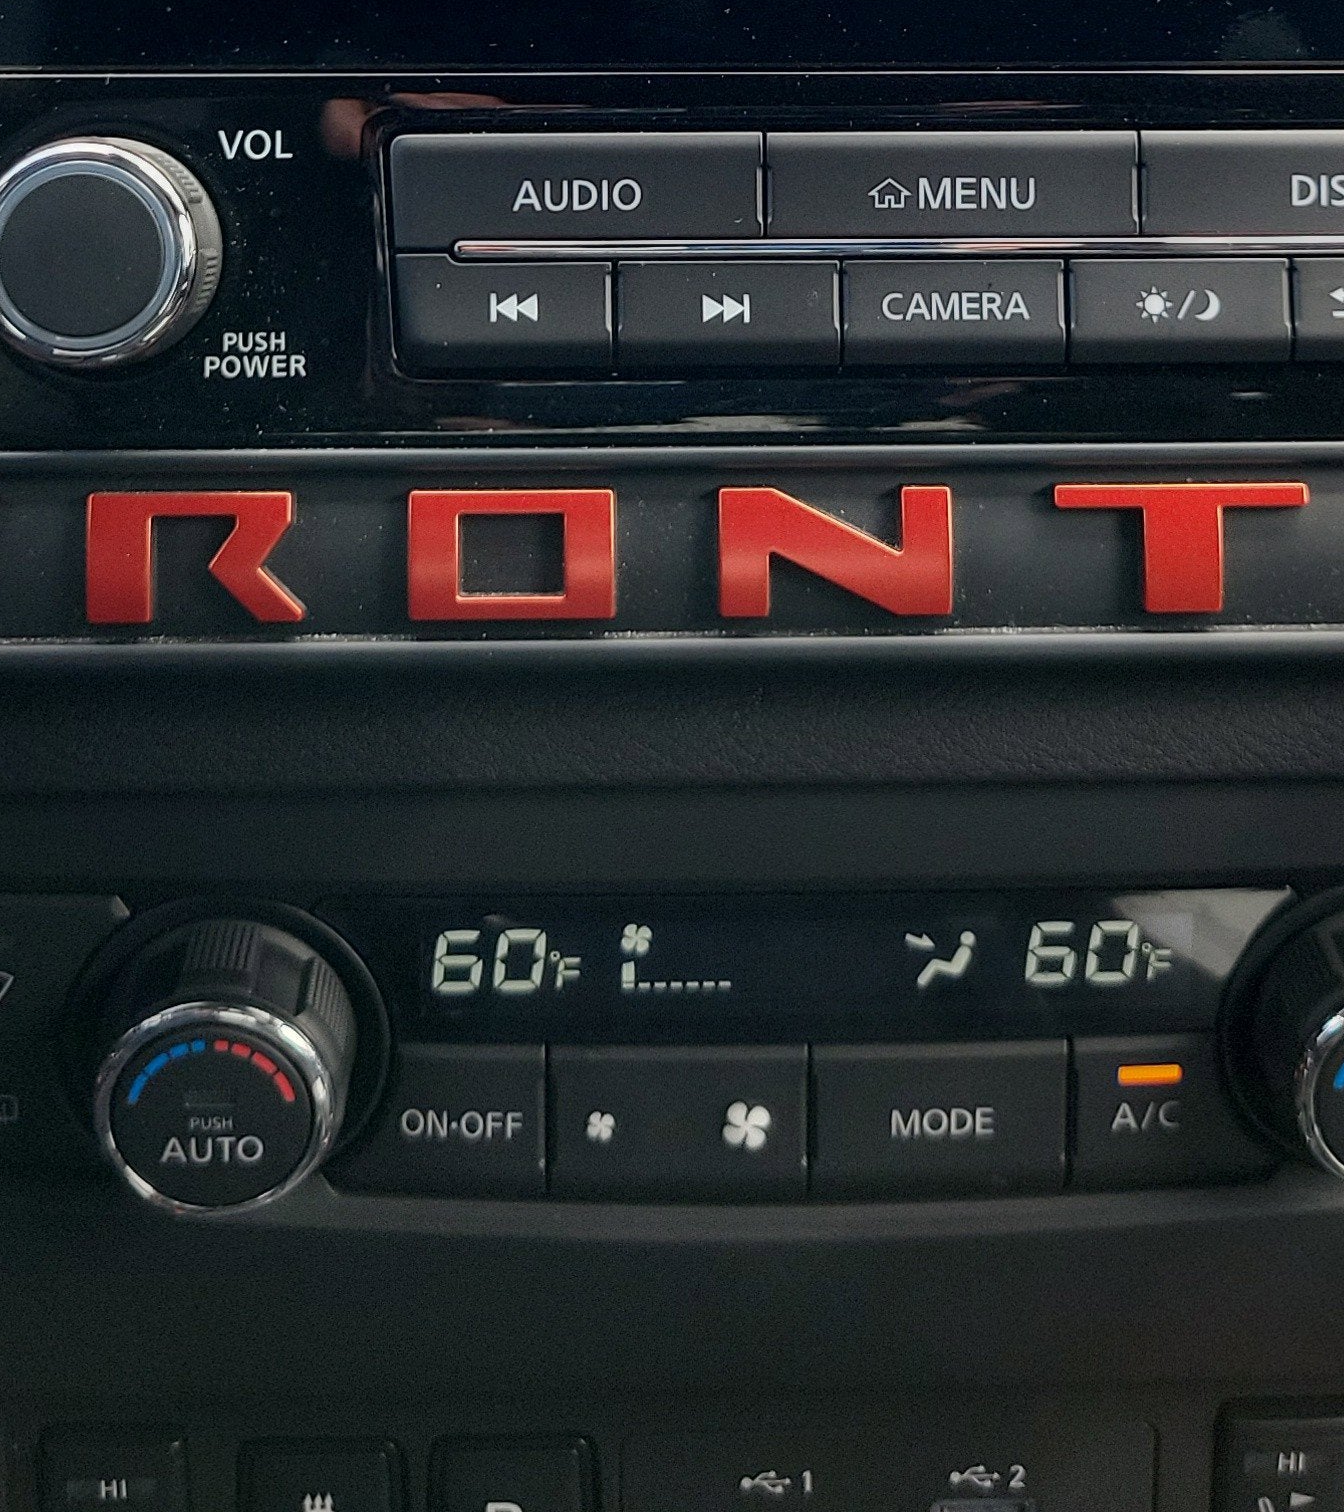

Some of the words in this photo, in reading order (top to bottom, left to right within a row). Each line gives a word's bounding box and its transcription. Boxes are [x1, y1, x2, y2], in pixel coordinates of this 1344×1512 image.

[219, 129, 294, 160] VOL
[511, 178, 644, 212] AUDIO
[918, 176, 1037, 210] MENU
[880, 291, 1030, 322] CAMERA
[222, 332, 287, 353] PUSH
[204, 355, 307, 379] POWER
[190, 1117, 233, 1130] PUSH
[891, 1108, 994, 1137] MODE
[1111, 1100, 1181, 1132] A/C
[161, 1137, 264, 1163] AUTO
[1278, 1452, 1305, 1472] HI
[801, 1472, 812, 1491] 1
[1009, 1465, 1026, 1487] 2
[100, 1480, 127, 1499] HI
